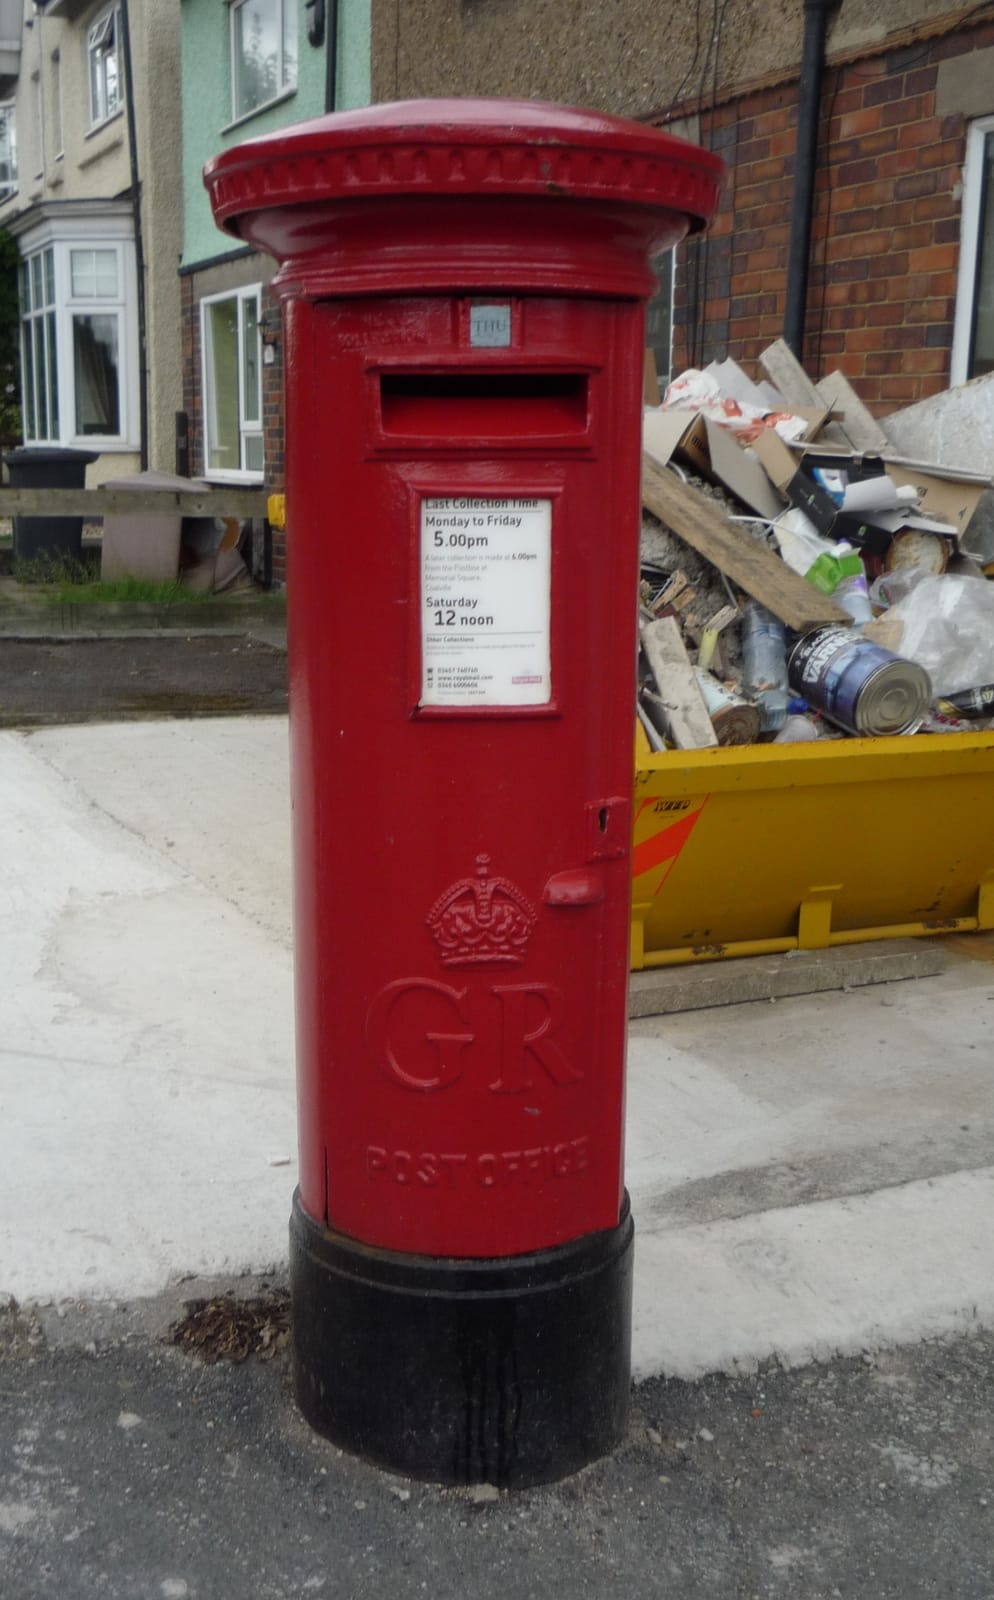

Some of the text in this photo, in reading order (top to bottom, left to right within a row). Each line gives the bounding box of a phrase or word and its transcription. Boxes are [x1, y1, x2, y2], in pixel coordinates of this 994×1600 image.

[473, 320, 507, 333] THU
[425, 497, 538, 509] Last Collection Time
[425, 515, 522, 528] Monday to Friday
[434, 530, 488, 548] 5.00pm
[426, 597, 478, 609] Saturday
[434, 610, 494, 626] 12 noon
[366, 977, 585, 1095] GR
[367, 1136, 589, 1187] POST OFFICE
